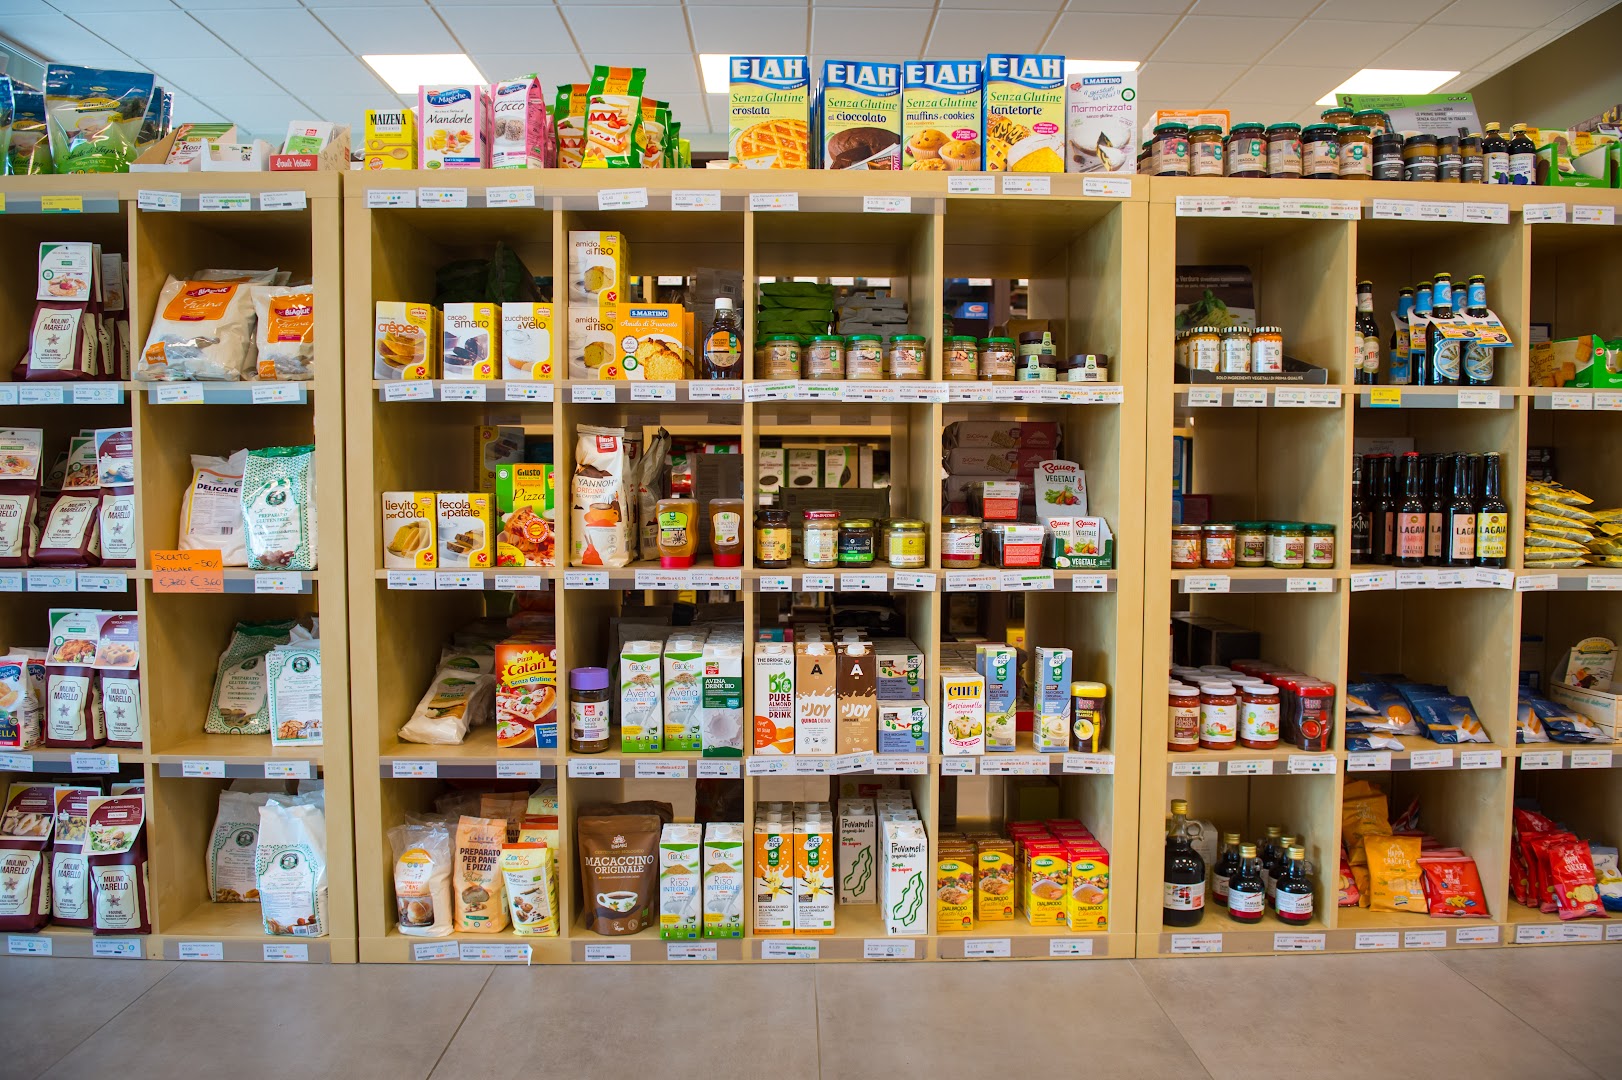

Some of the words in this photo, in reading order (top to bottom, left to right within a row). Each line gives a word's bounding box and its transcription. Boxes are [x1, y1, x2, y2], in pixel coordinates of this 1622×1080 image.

[731, 59, 804, 80] ELAH
[989, 57, 1061, 81] ELAH
[827, 63, 898, 89] ELAH
[905, 64, 976, 86] ELAH
[438, 93, 467, 105] Magiche
[731, 93, 766, 103] Senza
[768, 92, 804, 103] Glutine
[990, 91, 1022, 103] Senza
[1022, 91, 1062, 103] Glutine
[494, 101, 525, 113] Cocco
[827, 98, 863, 109] Senza
[864, 99, 899, 111] Glutine
[906, 97, 938, 108] Senza
[939, 97, 978, 108] Glutine
[732, 106, 771, 115] crostata
[990, 103, 1043, 115] tantetorte
[1071, 103, 1133, 113] Marmorizzata
[370, 113, 407, 125] MAIZENA
[426, 114, 473, 124] Mandorle
[837, 111, 887, 124] cioccolato
[906, 109, 940, 120] muffins
[943, 109, 976, 120] cookies
[586, 246, 593, 255] di
[594, 244, 614, 255] riso
[453, 318, 490, 329] amaro
[504, 315, 536, 323] zucchero
[521, 318, 548, 330] velo
[43, 322, 71, 332] MARELLO
[378, 321, 419, 336] crêpes
[586, 323, 593, 331] di
[594, 320, 614, 331] riso
[1042, 462, 1077, 473] Bauer
[578, 479, 615, 488] YANNOH
[1045, 475, 1076, 483] VEGETALE
[197, 483, 240, 494] DELICAKE
[513, 488, 547, 502] Pizza
[385, 500, 418, 512] lievito
[439, 500, 471, 511] fecola
[107, 510, 131, 519] MARELLO
[386, 513, 398, 523] per
[397, 509, 425, 519] dolci
[447, 509, 481, 519] patate
[1050, 520, 1071, 528] Bauer
[1075, 519, 1097, 528] Bauer
[1286, 543, 1304, 551] PESTO
[1313, 543, 1333, 551] PESTO
[154, 552, 191, 561] SCONTO
[1071, 557, 1097, 566] VEGETALE
[516, 655, 533, 663] Pizza
[507, 658, 546, 676] Catarì
[529, 675, 552, 683] Glutine
[704, 678, 726, 686] AVENA
[110, 687, 128, 695] MULINO
[669, 687, 698, 697] Avena
[704, 684, 724, 693] DRINK
[725, 683, 735, 692] BIO
[948, 685, 981, 697] CHEF
[53, 692, 79, 701] MARELLO
[108, 694, 133, 703] MARELLO
[626, 690, 656, 698] Avena
[768, 694, 792, 702] PURE
[768, 711, 792, 719] DRINK
[842, 817, 869, 829] Provamel
[460, 847, 501, 855] PREPARATO
[891, 842, 922, 853] Provamel
[1387, 847, 1405, 857] HAPPY
[5, 859, 28, 867] MULINO
[463, 855, 477, 863] PER
[478, 856, 497, 864] PANE
[585, 854, 655, 867] MACACCINO
[1383, 856, 1411, 867] CRACKER
[1563, 854, 1578, 865] HAPPY
[472, 864, 492, 872] PIZZA
[594, 866, 645, 874] ORIGINALE
[1563, 861, 1588, 873] CRACKER
[57, 869, 81, 879] MARELLO
[104, 875, 124, 883] MULINO
